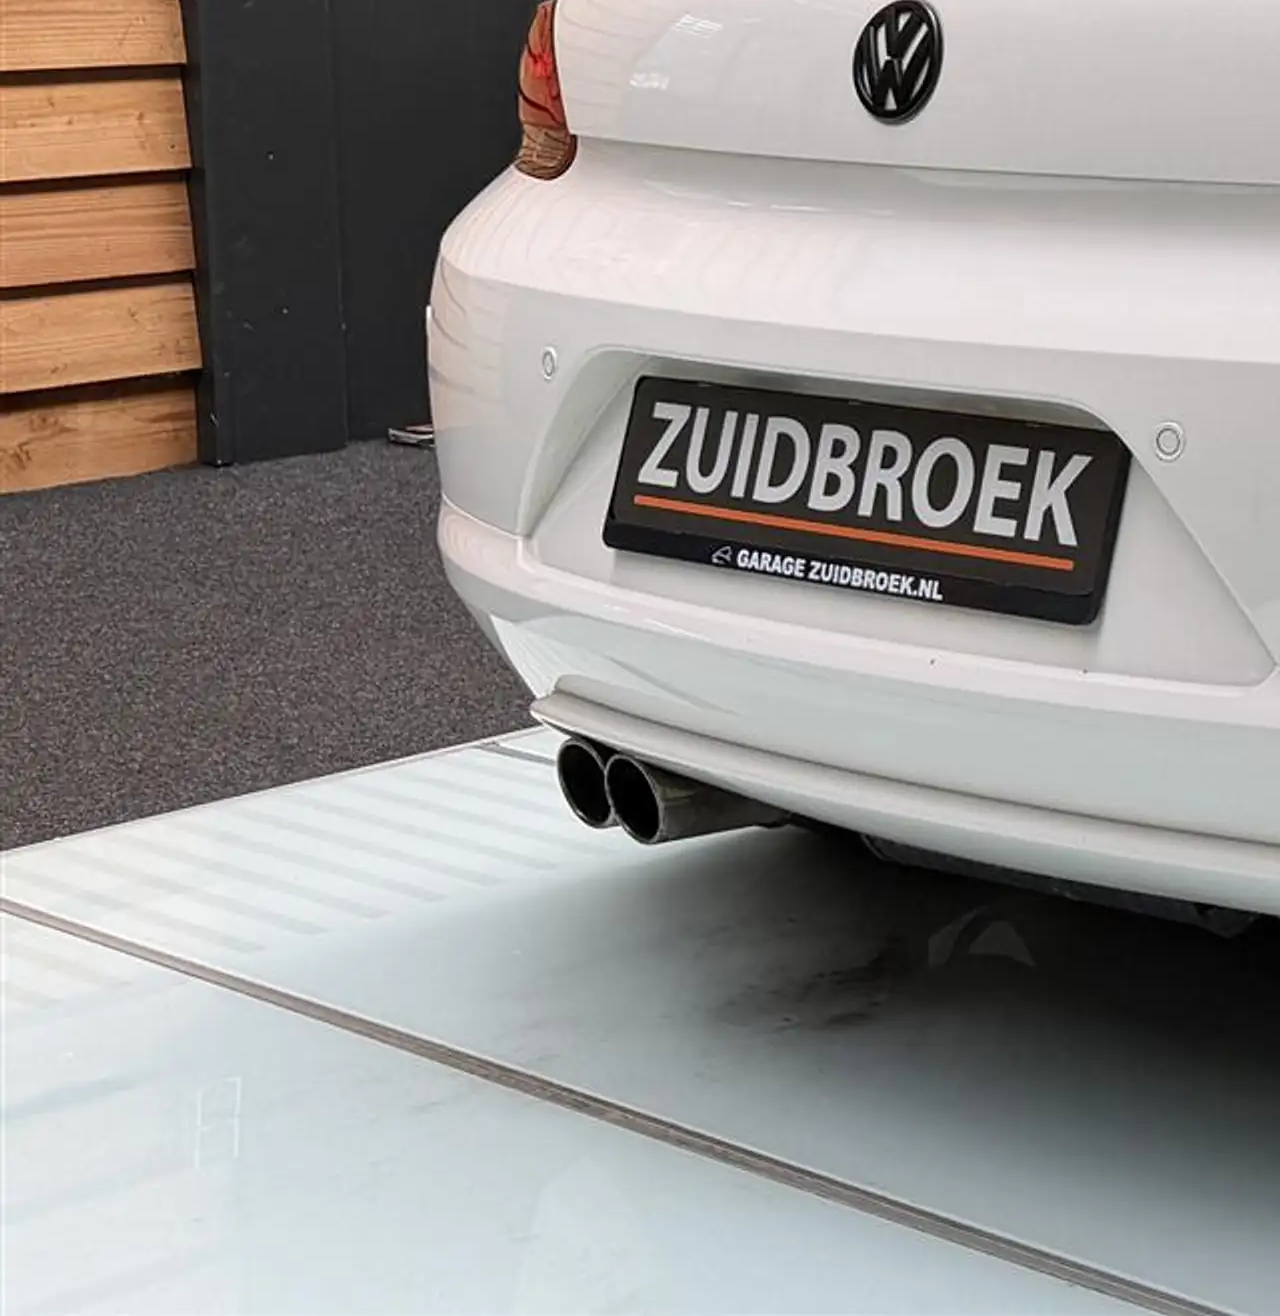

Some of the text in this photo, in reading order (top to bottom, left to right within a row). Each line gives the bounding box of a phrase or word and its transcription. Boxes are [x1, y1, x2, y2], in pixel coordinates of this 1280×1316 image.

[637, 401, 1093, 547] ZUIDBROEK
[736, 548, 944, 602] GARAGE ZUIDBROEK.NL
